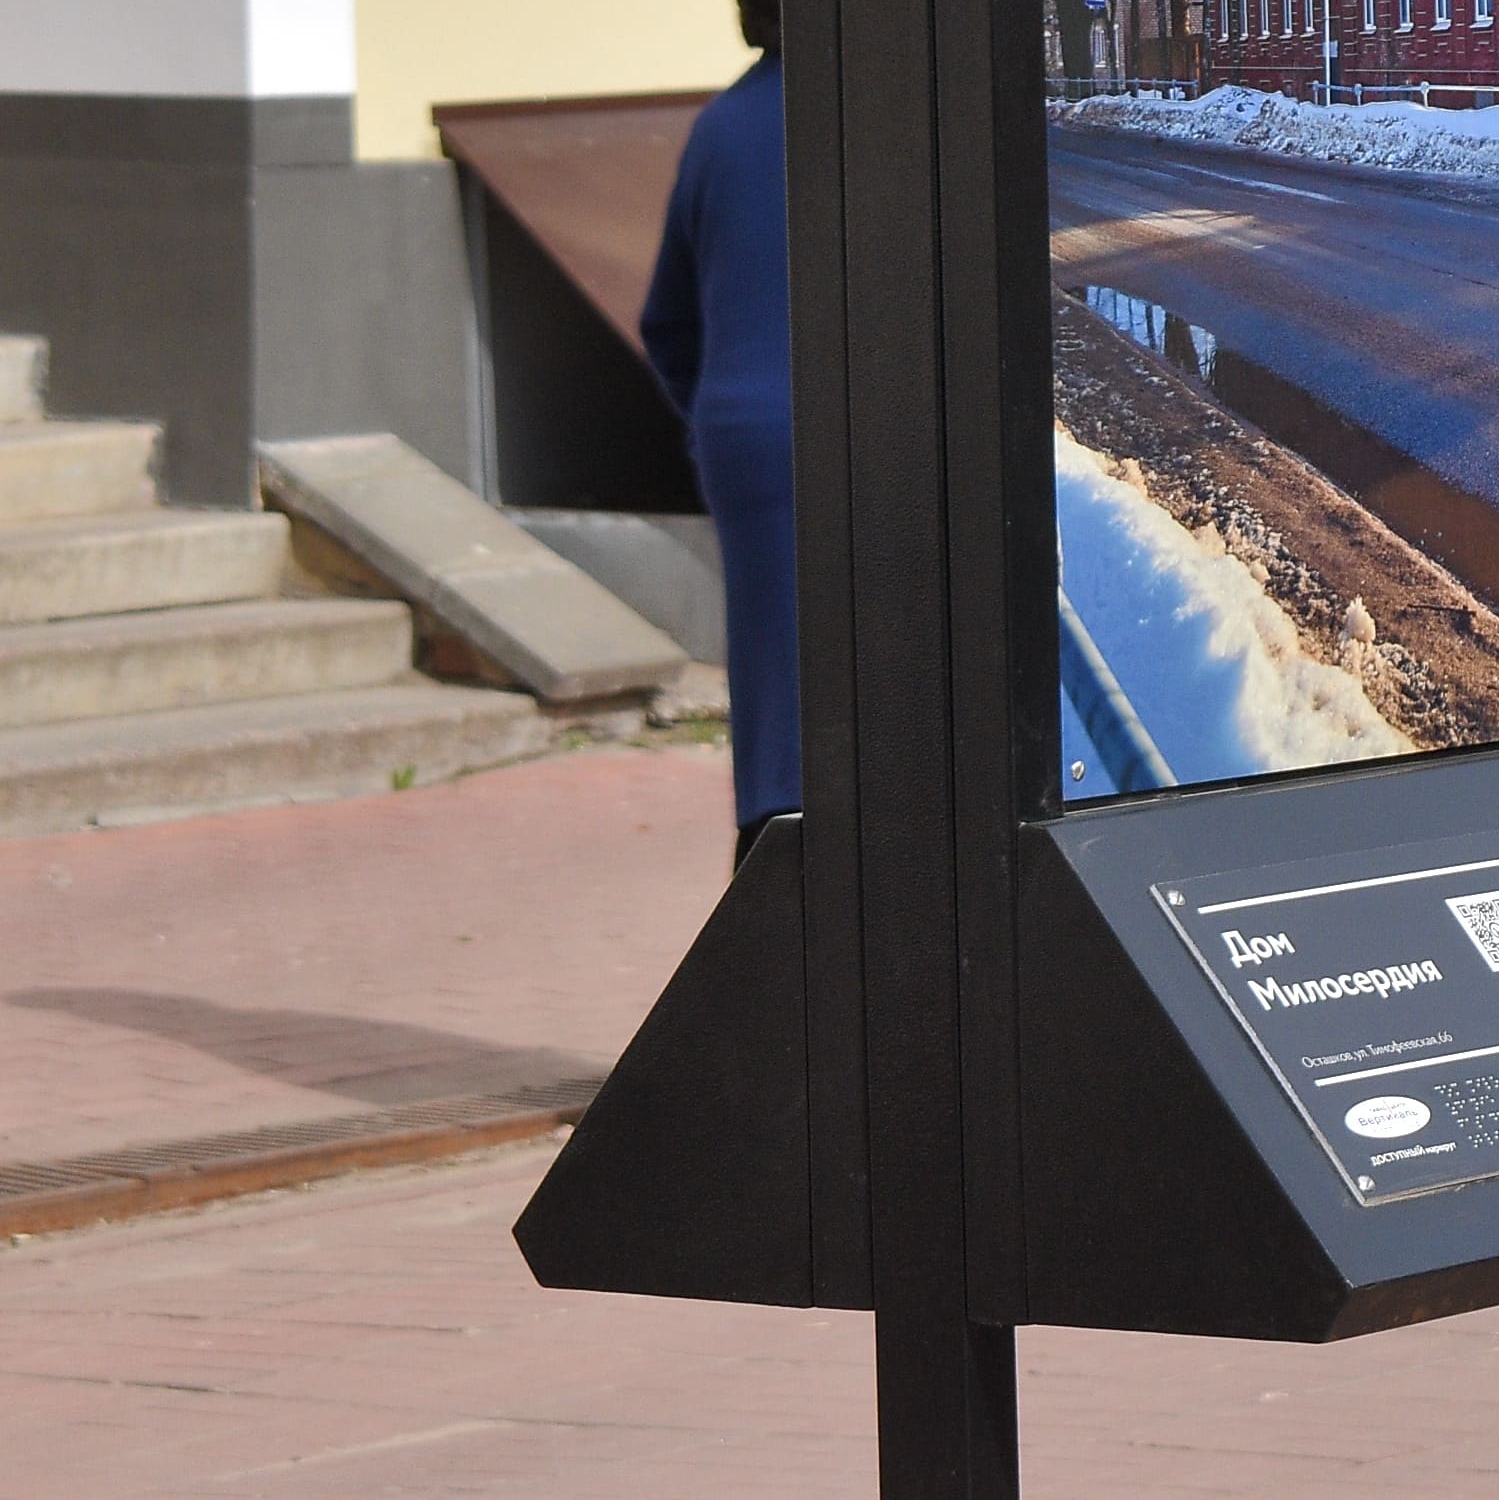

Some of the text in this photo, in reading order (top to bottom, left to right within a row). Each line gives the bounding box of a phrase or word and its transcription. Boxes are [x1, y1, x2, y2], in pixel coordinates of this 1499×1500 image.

[1221, 929, 1296, 969] Дом
[1247, 959, 1443, 1011] Милосердия
[1366, 1036, 1441, 1055] Тимофеевская,
[1437, 1030, 1453, 1043] 66
[1357, 1108, 1419, 1128] Вертикаль
[1370, 1144, 1426, 1166] ДОСТУПНЫЙ
